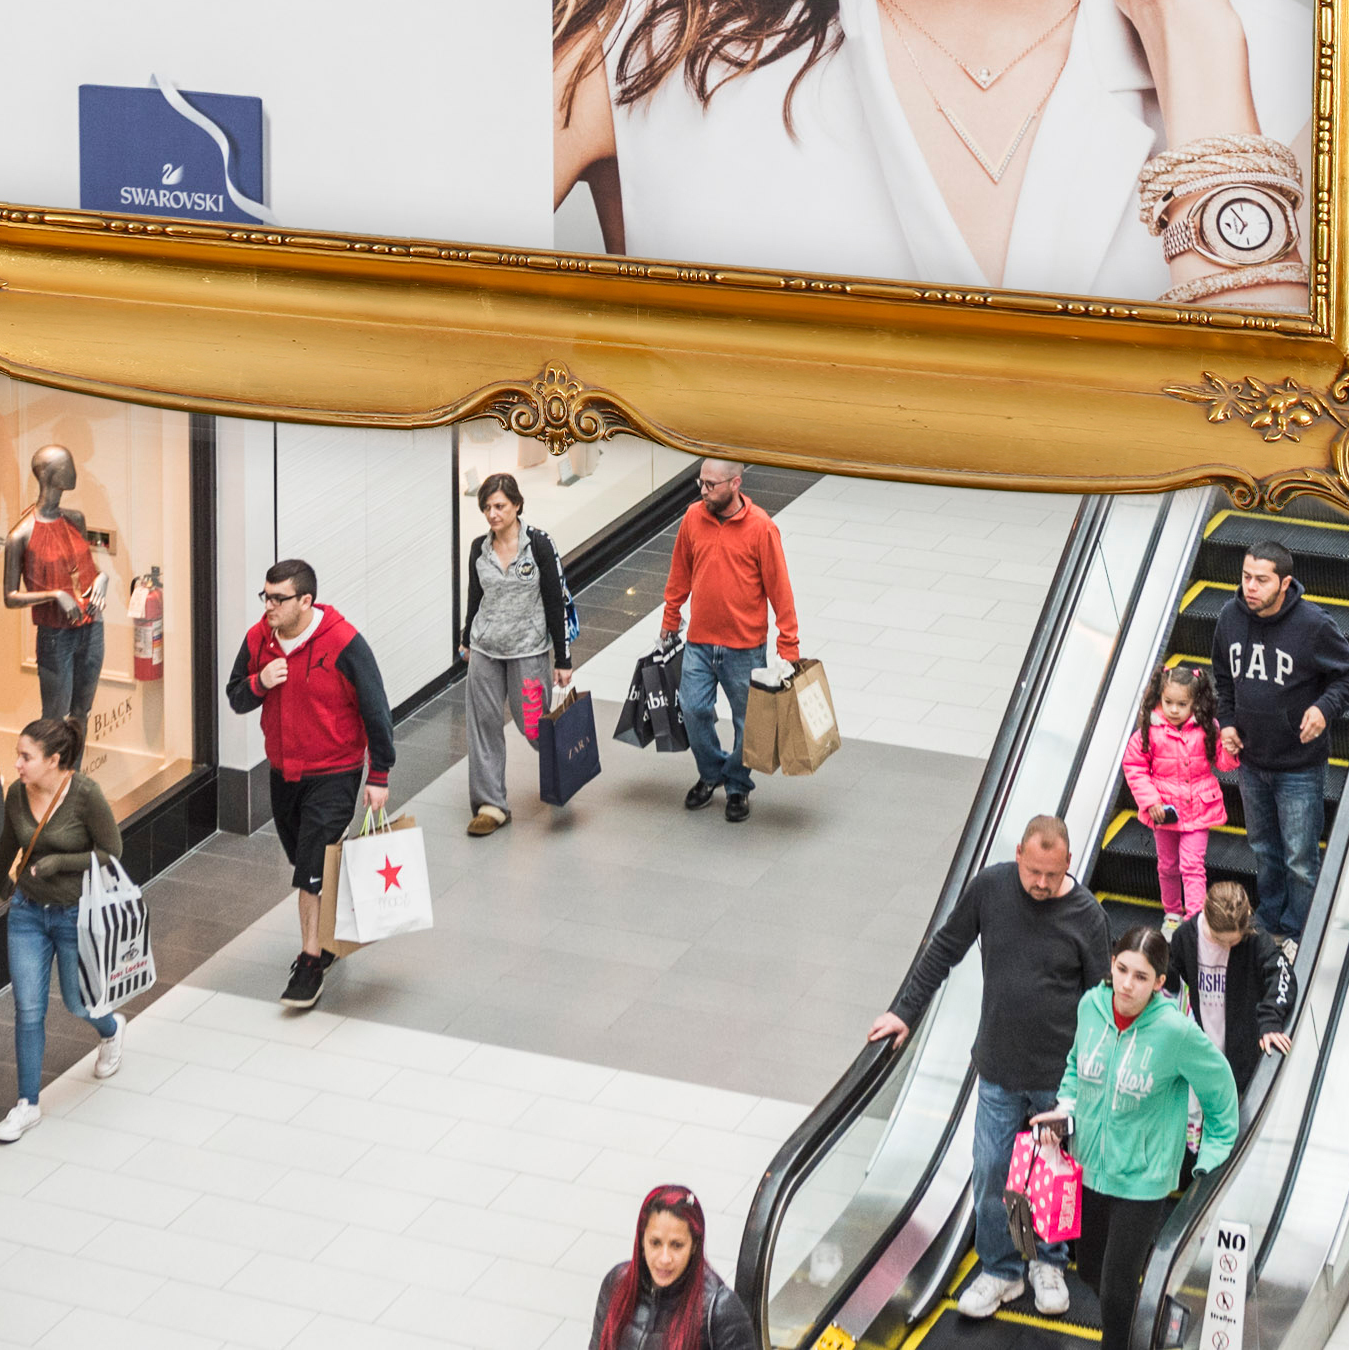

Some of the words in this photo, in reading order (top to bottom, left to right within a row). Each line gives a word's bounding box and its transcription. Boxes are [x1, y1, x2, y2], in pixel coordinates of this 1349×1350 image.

[120, 186, 224, 212] SWAROVSKI
[1229, 642, 1293, 686] GAP
[94, 697, 132, 733] BLACK
[1217, 1229, 1246, 1251] NO
